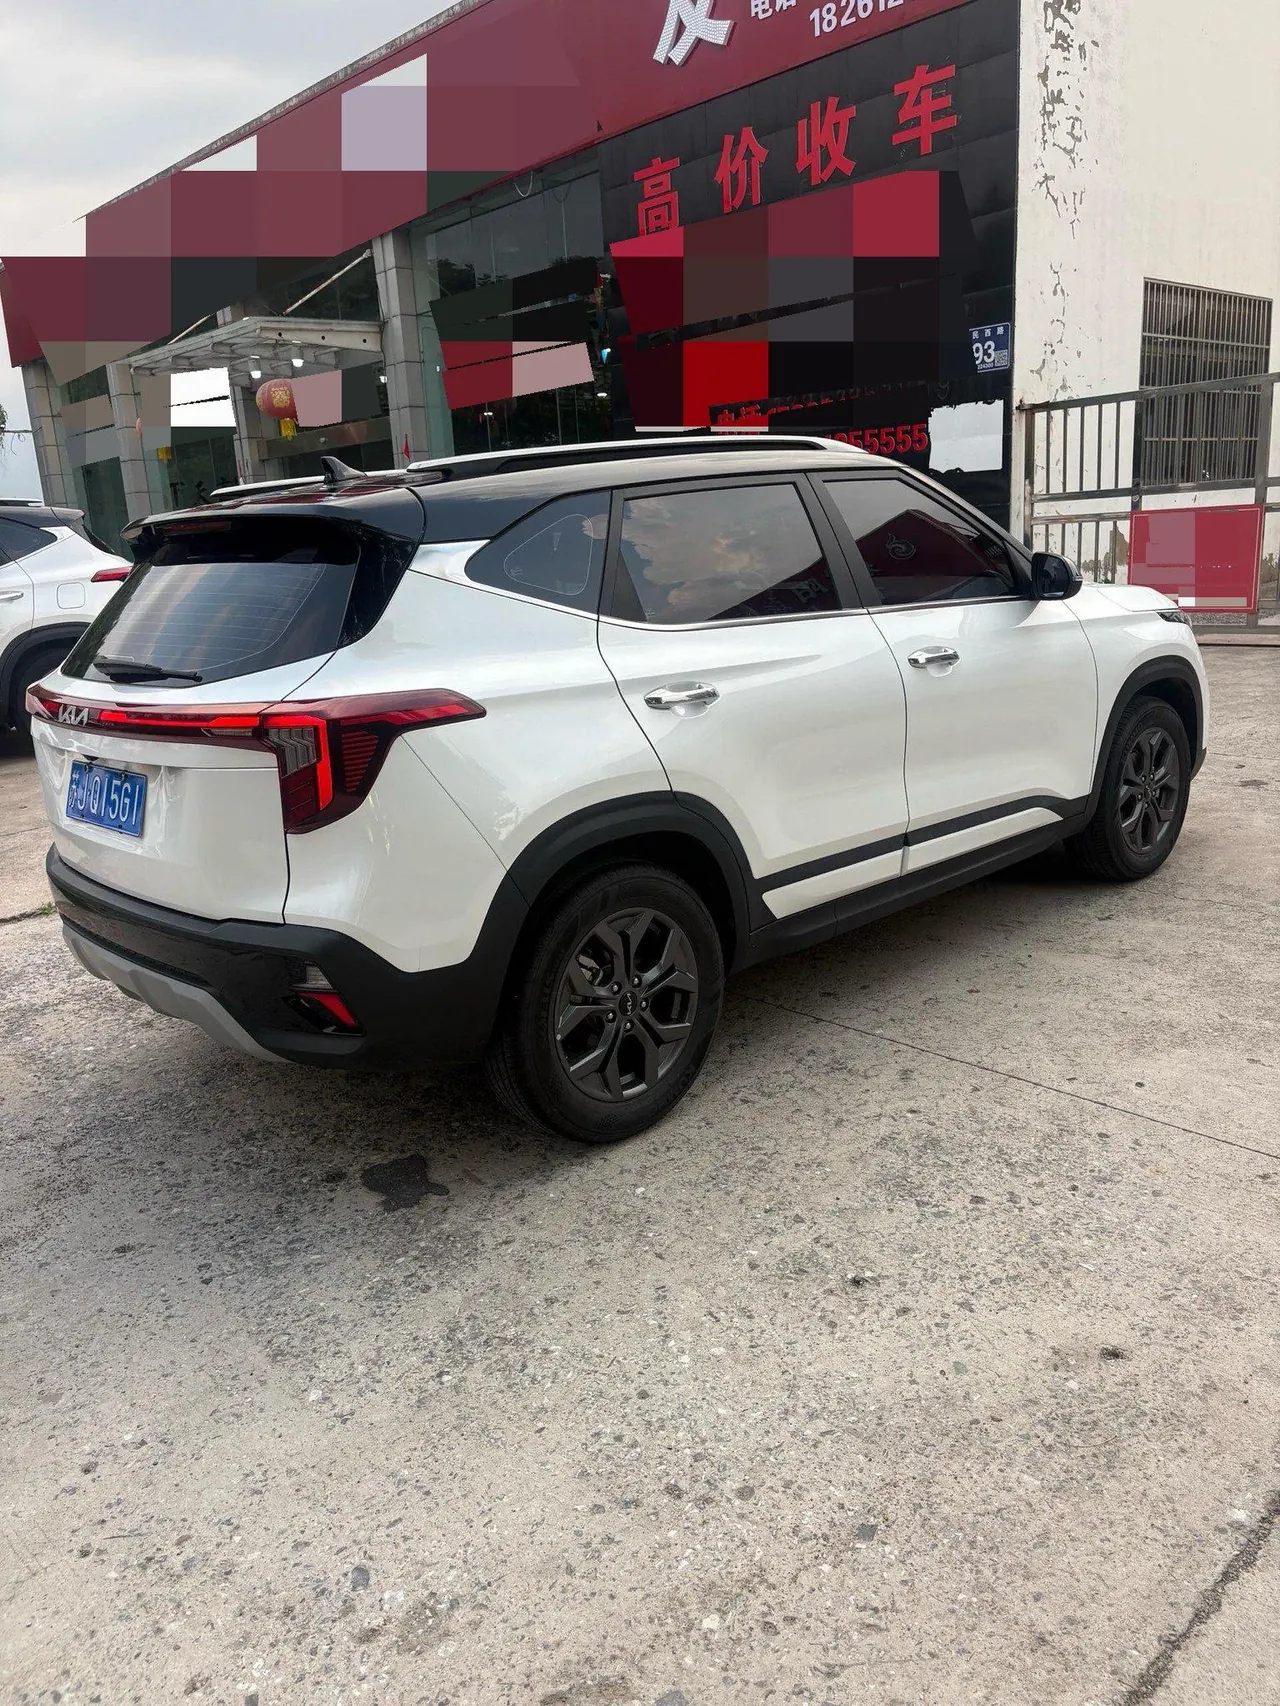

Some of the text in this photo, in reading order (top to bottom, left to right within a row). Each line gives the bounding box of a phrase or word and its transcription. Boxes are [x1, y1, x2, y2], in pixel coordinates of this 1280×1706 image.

[633, 64, 958, 236] 高价收车
[972, 340, 995, 365] 93
